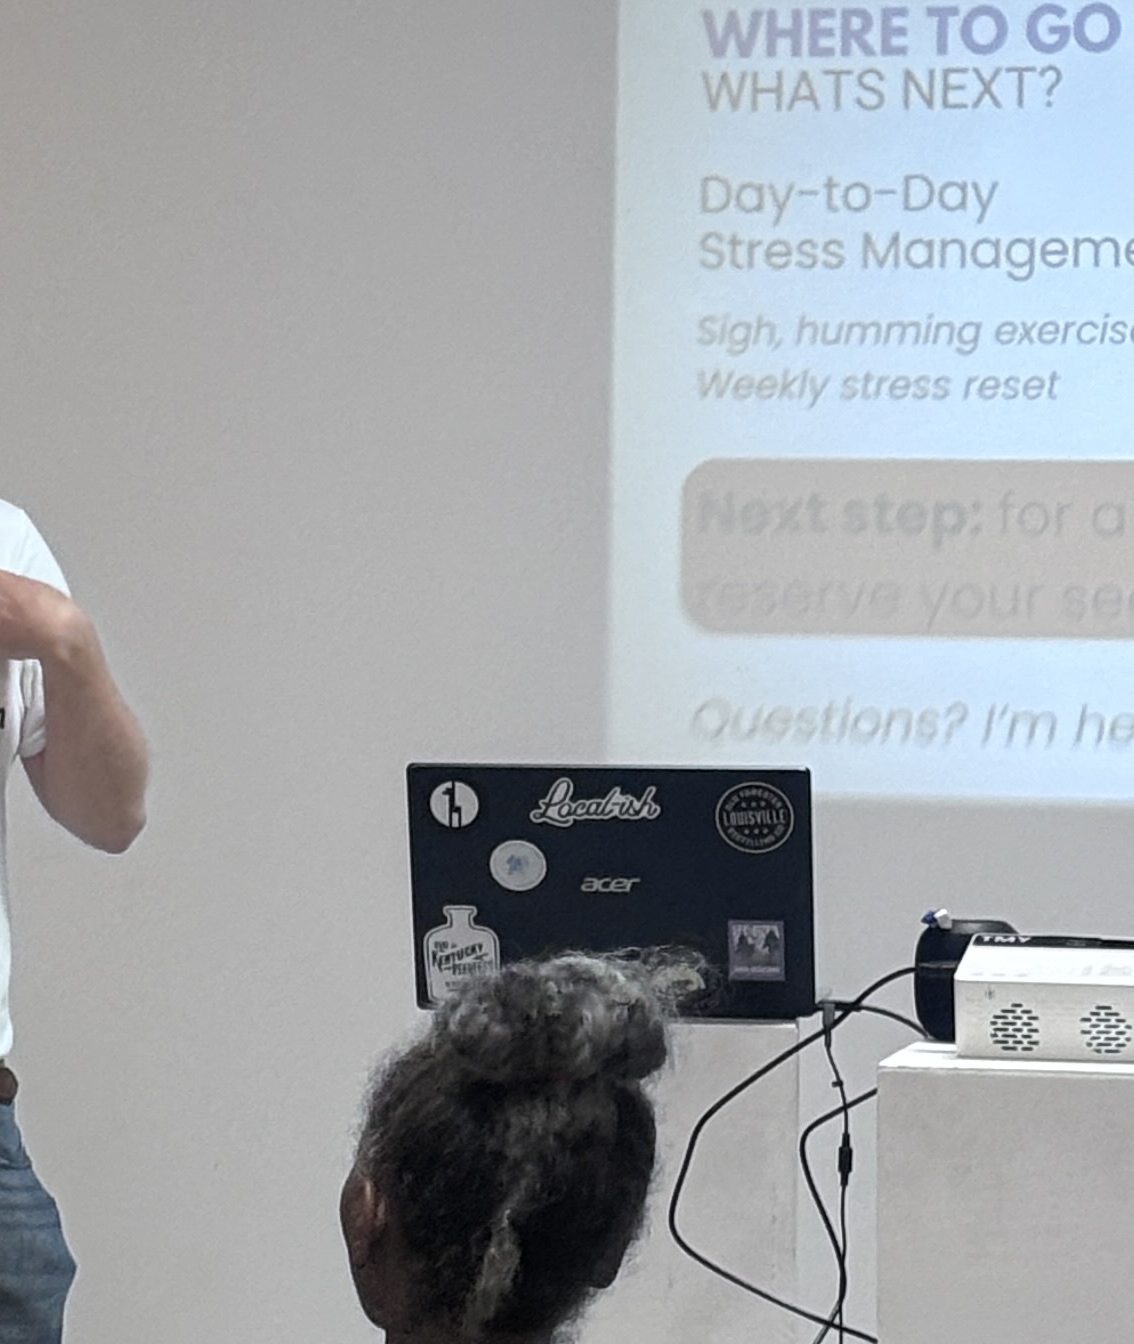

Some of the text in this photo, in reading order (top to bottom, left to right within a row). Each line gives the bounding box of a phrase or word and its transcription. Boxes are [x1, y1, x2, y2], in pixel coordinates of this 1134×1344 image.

[701, 1, 1123, 58] WHERE TO GO
[702, 65, 1064, 113] WHATS NEXT?
[699, 173, 1000, 227] Day-to-Day
[699, 232, 845, 271] Stress
[697, 313, 1134, 356] Sigh, humming exercis
[697, 368, 1061, 410] Weekly stress reset
[699, 491, 829, 535] Next
[843, 493, 982, 551] step:
[1000, 489, 1073, 536] for
[696, 579, 1134, 630] reserve your se
[693, 697, 968, 743] Questions?
[982, 702, 1059, 750] I'm
[723, 808, 786, 827] LOUISVILLE
[580, 877, 641, 893] acer
